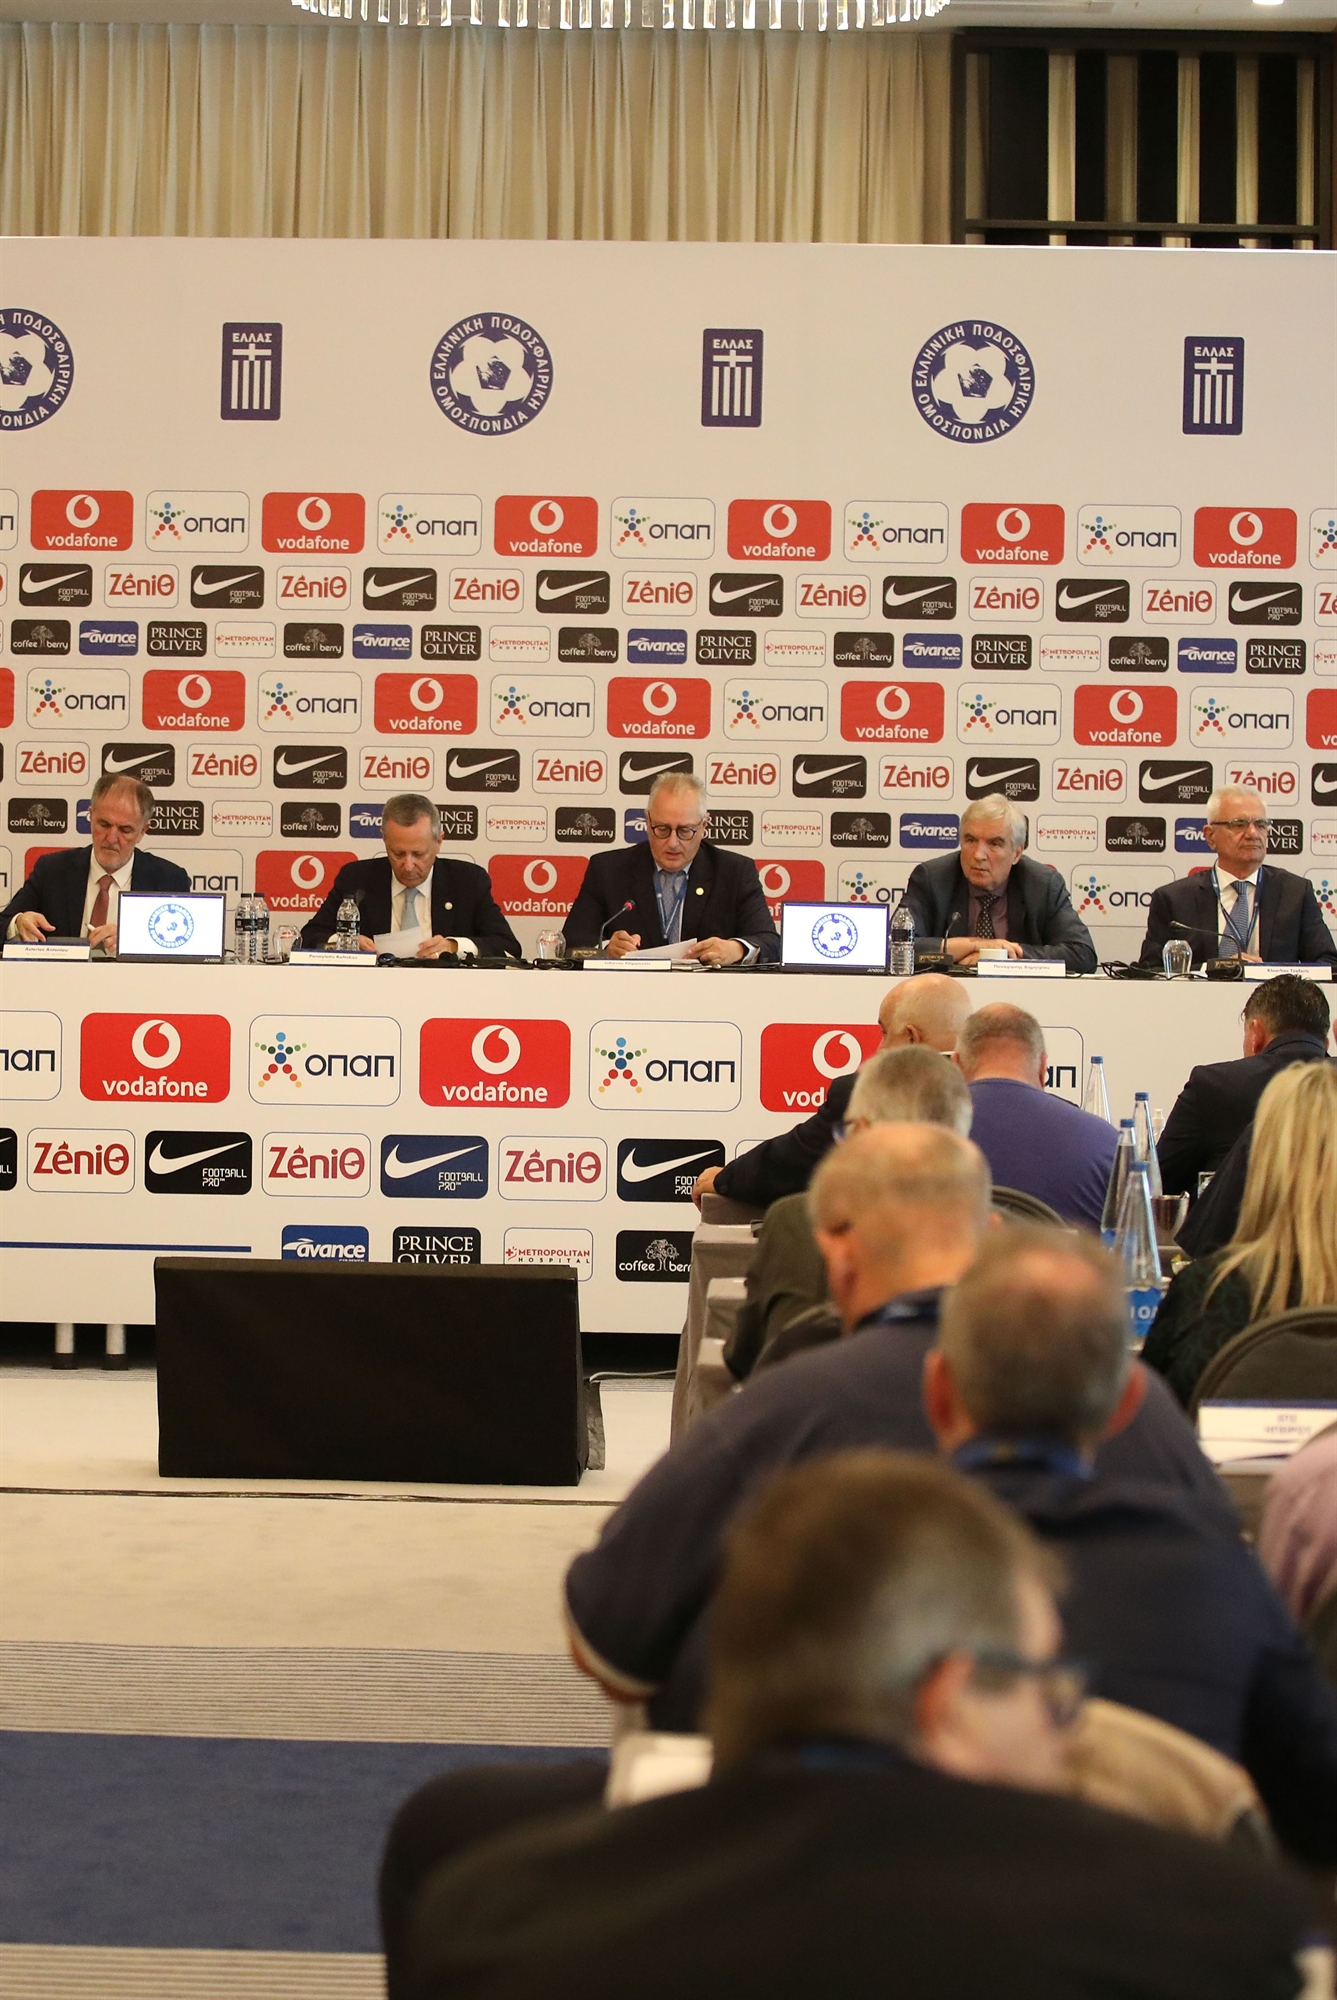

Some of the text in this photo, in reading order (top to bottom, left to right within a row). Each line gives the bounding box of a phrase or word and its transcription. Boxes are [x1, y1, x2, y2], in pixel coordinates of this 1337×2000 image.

[232, 333, 272, 343] ΕΛΛΑΣ
[713, 339, 753, 349] ΕΛΛΑΣ
[1194, 347, 1234, 357] ΕΛΛΑΣ
[12, 312, 71, 406] ΠΟΔΟΣΦΑΙΡΙΚΗ
[434, 316, 550, 432] ΕΛΛΗΝΙΚΗ ΠΟΔΟΣΦΑΙΡΙΚΗ ΟΜΟΣΠΟΝΔΙΑ
[916, 324, 1031, 440] ΕΛΛΗΝΙΚΗ ΠΟΔΟΣΦΑΙΡΙΚΗ ΟΜΟΣΠΟΝΔΙΑ
[46, 533, 118, 548] vodafone
[277, 536, 349, 551] vodafone
[510, 539, 582, 554] vodafone
[743, 543, 815, 558] vodafone
[977, 547, 1049, 562] vodafone
[1209, 551, 1281, 566] vodafone
[58, 588, 89, 596] FOOTBALL
[230, 590, 261, 598] FOOTBALL
[402, 592, 433, 600] FOOTBALL
[575, 595, 606, 603] FOOTBALL
[749, 598, 780, 606] FOOTBALL
[922, 601, 953, 609] FOOTBALL
[1095, 604, 1126, 612] FOOTBALL
[1268, 607, 1299, 615] FOOTBALL
[87, 630, 137, 644] avance
[151, 627, 202, 639] PRINCE
[425, 631, 476, 643] PRINCE
[12, 638, 68, 650] coffee berry
[150, 639, 203, 652] OLIVER
[361, 633, 411, 647] avance
[636, 638, 686, 652] avance
[700, 636, 751, 648] PRINCE
[975, 640, 1026, 652] PRINCE
[285, 641, 341, 653] coffee berry
[424, 643, 477, 656] OLIVER
[559, 646, 616, 658] coffee berry
[911, 643, 961, 657] avance
[1250, 645, 1301, 657] PRINCE
[699, 648, 752, 661] OLIVER
[835, 651, 891, 663] coffee berry
[974, 652, 1027, 665] OLIVER
[1186, 647, 1236, 661] avance
[1110, 655, 1166, 667] coffee berry
[1249, 657, 1302, 670] OLIVER
[158, 713, 230, 728] vodafone
[390, 717, 462, 732] vodafone
[623, 721, 695, 736] vodafone
[857, 725, 929, 740] vodafone
[1090, 729, 1162, 744] vodafone
[141, 768, 172, 776] FOOTBALL
[313, 770, 344, 778] FOOTBALL
[485, 773, 516, 781] FOOTBALL
[832, 780, 863, 788] FOOTBALL
[1005, 782, 1036, 790] FOOTBALL
[1178, 785, 1209, 793] FOOTBALL
[440, 811, 473, 822] INCE
[707, 816, 749, 827] RINCE
[9, 817, 65, 829] coffee berry
[149, 818, 200, 830] OLIVER
[282, 821, 338, 833] coffee berry
[441, 823, 474, 834] IVER
[556, 826, 613, 838] coffee berry
[908, 823, 958, 837] avance
[832, 831, 888, 843] coffee berry
[1107, 835, 1163, 847] coffee berry
[271, 895, 324, 908] vodafo
[103, 1076, 208, 1097] vodafone
[442, 1082, 548, 1102] vodafone
[202, 1168, 248, 1179] FOOTBALL
[438, 1172, 483, 1183] FOOTBALL
[675, 1176, 698, 1186] FOOT
[297, 1241, 366, 1258] avance
[399, 1236, 474, 1252] PRINCE
[518, 1248, 590, 1258] METROPOLITAN
[619, 1259, 655, 1272] coffee
